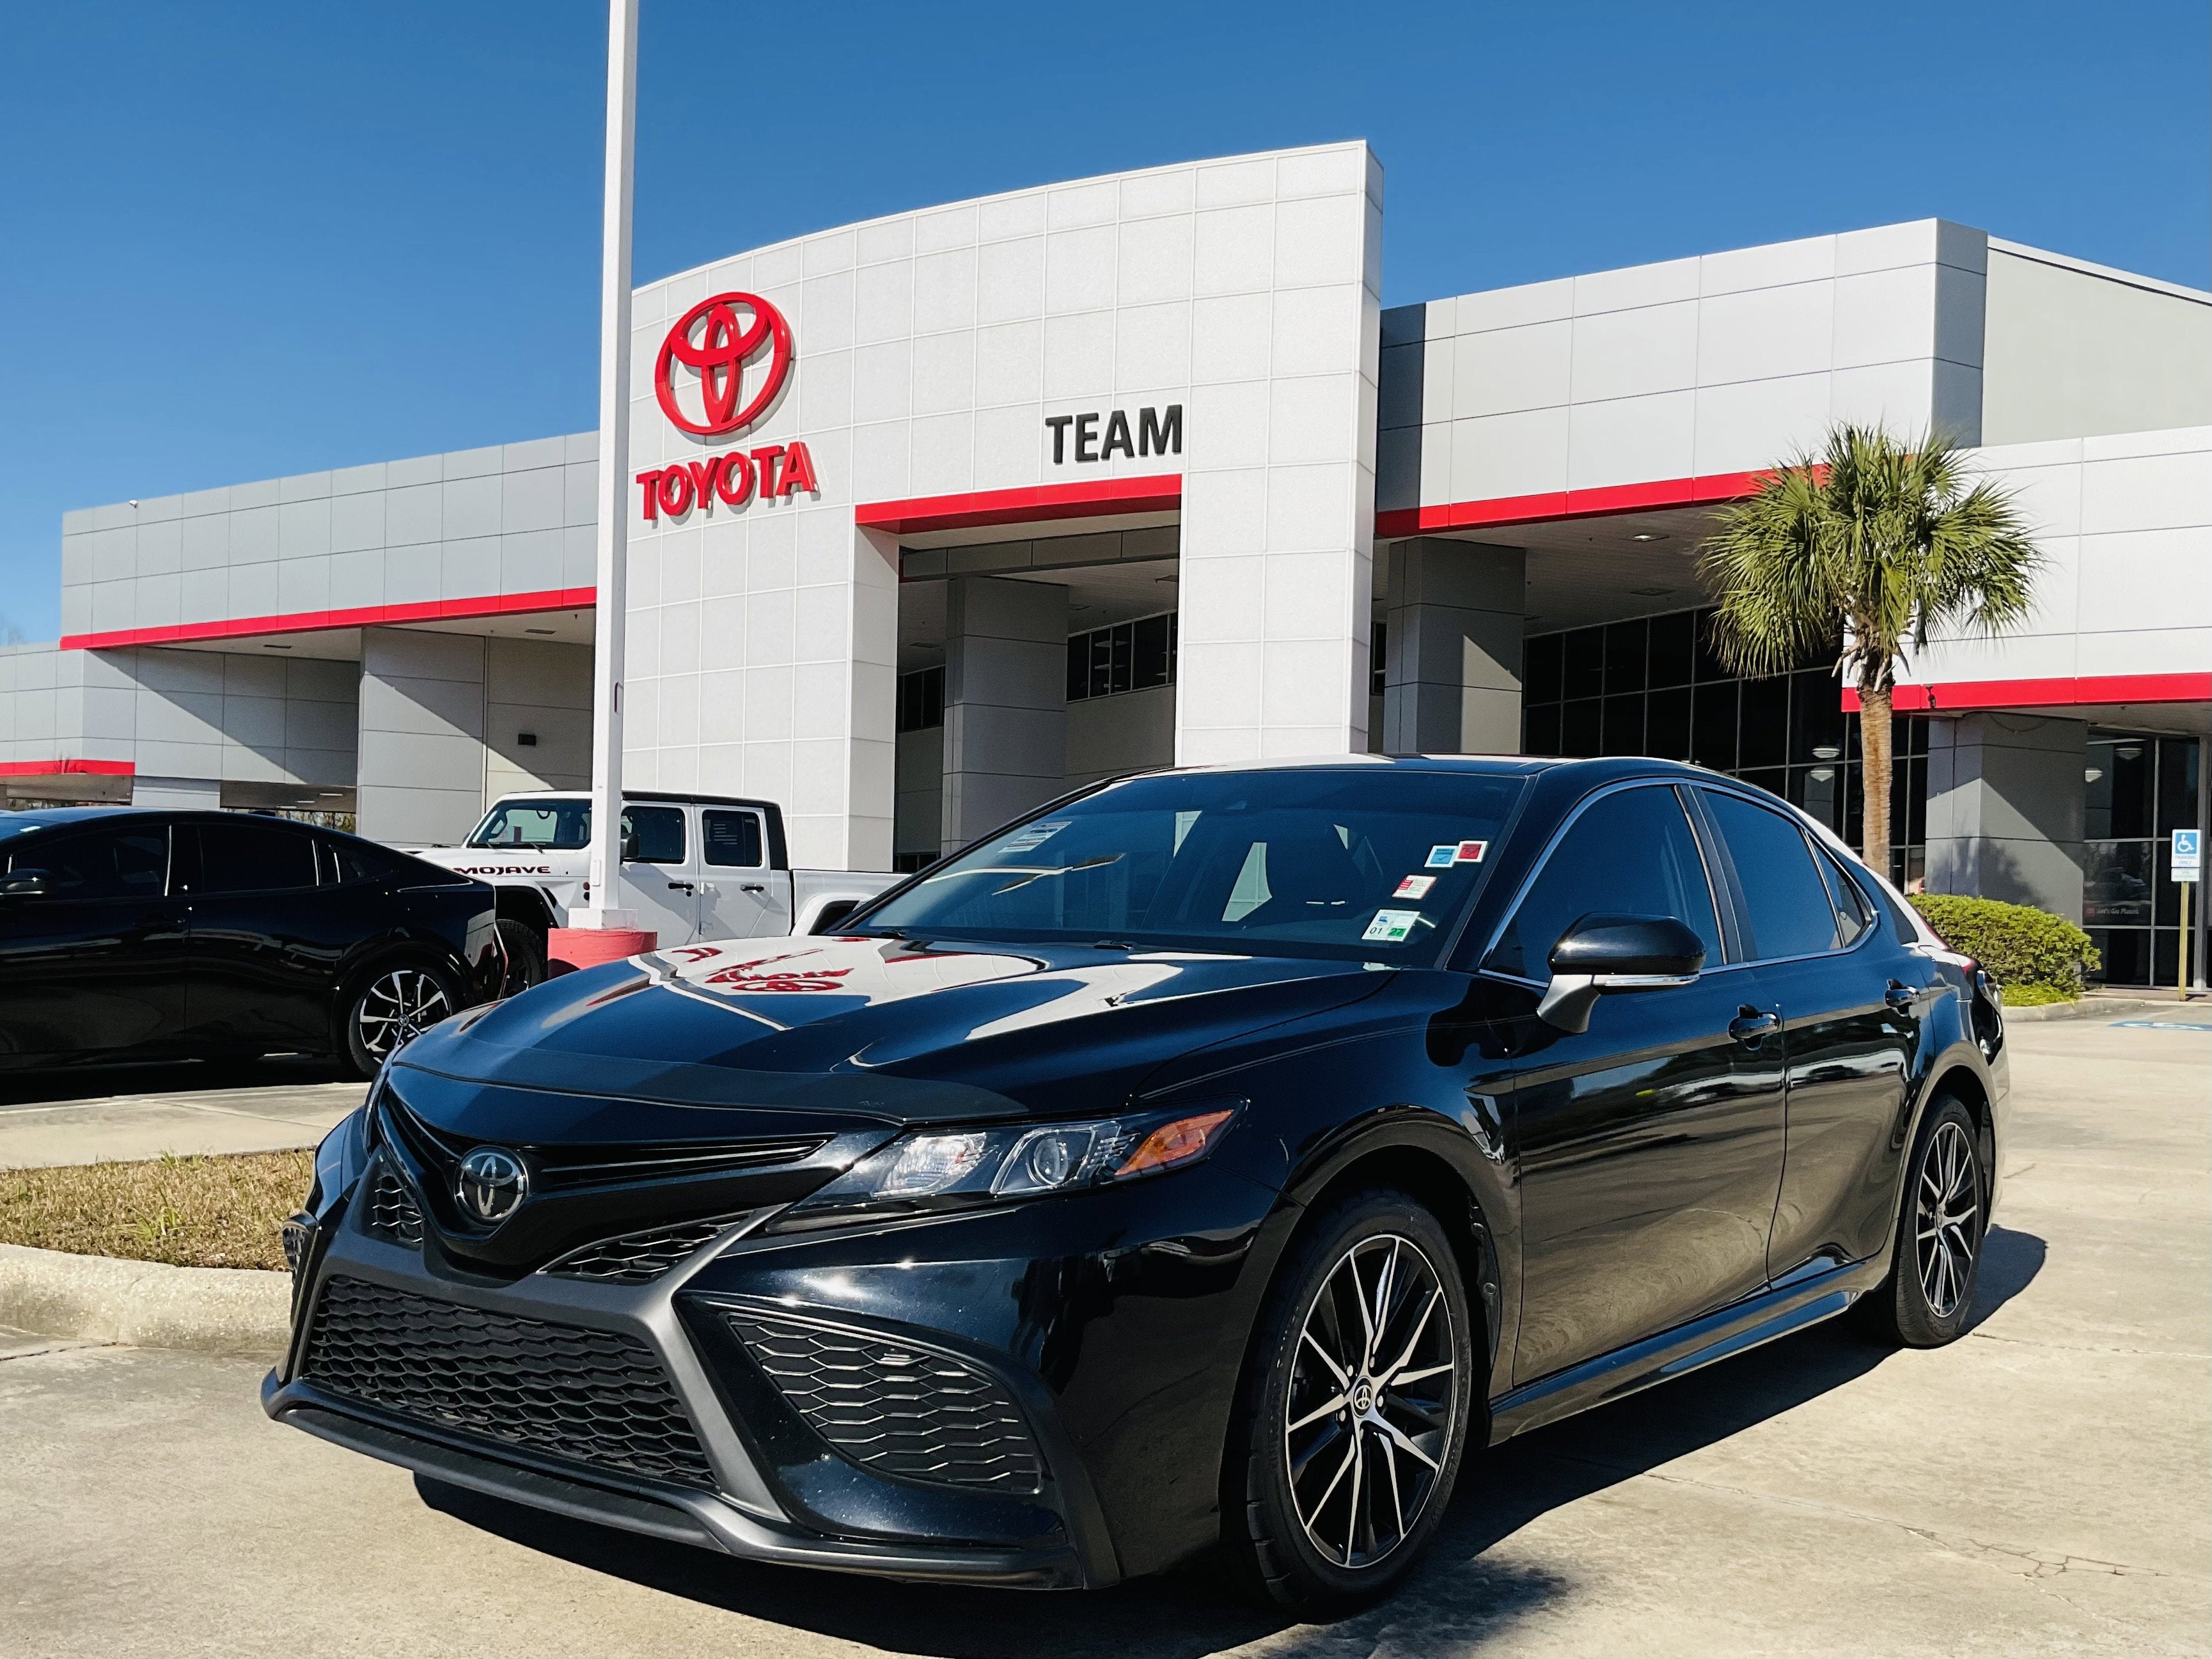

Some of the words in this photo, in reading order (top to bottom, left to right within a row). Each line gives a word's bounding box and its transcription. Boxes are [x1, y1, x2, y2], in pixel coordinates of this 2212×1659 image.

[1044, 404, 1182, 464] TEAM
[636, 441, 819, 521] TOYOTA
[453, 866, 551, 875] MOJAVE
